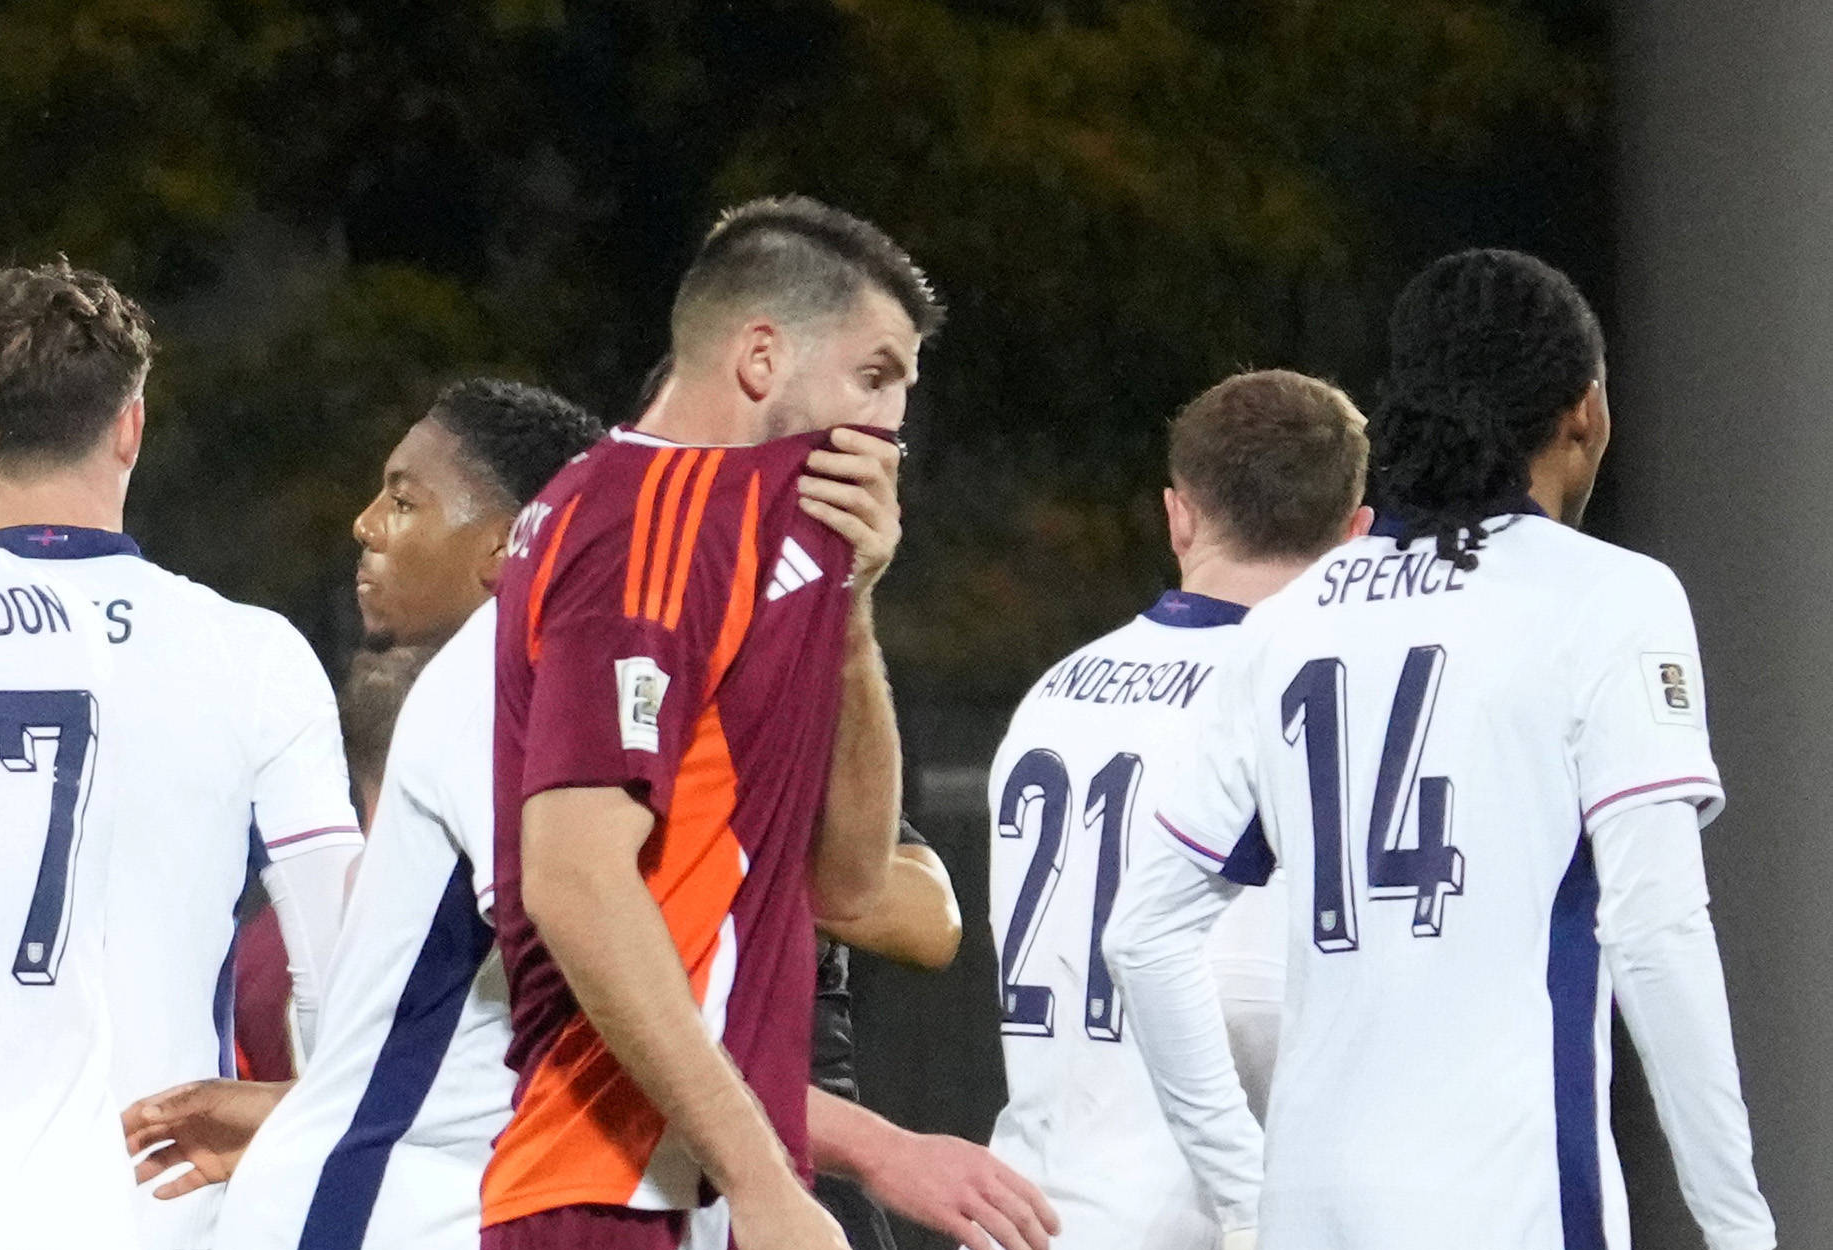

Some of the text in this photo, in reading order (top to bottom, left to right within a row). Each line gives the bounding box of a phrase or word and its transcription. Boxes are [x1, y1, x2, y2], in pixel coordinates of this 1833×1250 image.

[1039, 654, 1214, 709] ANDERSON
[1280, 644, 1465, 953] 14
[998, 748, 1144, 1042] 21
